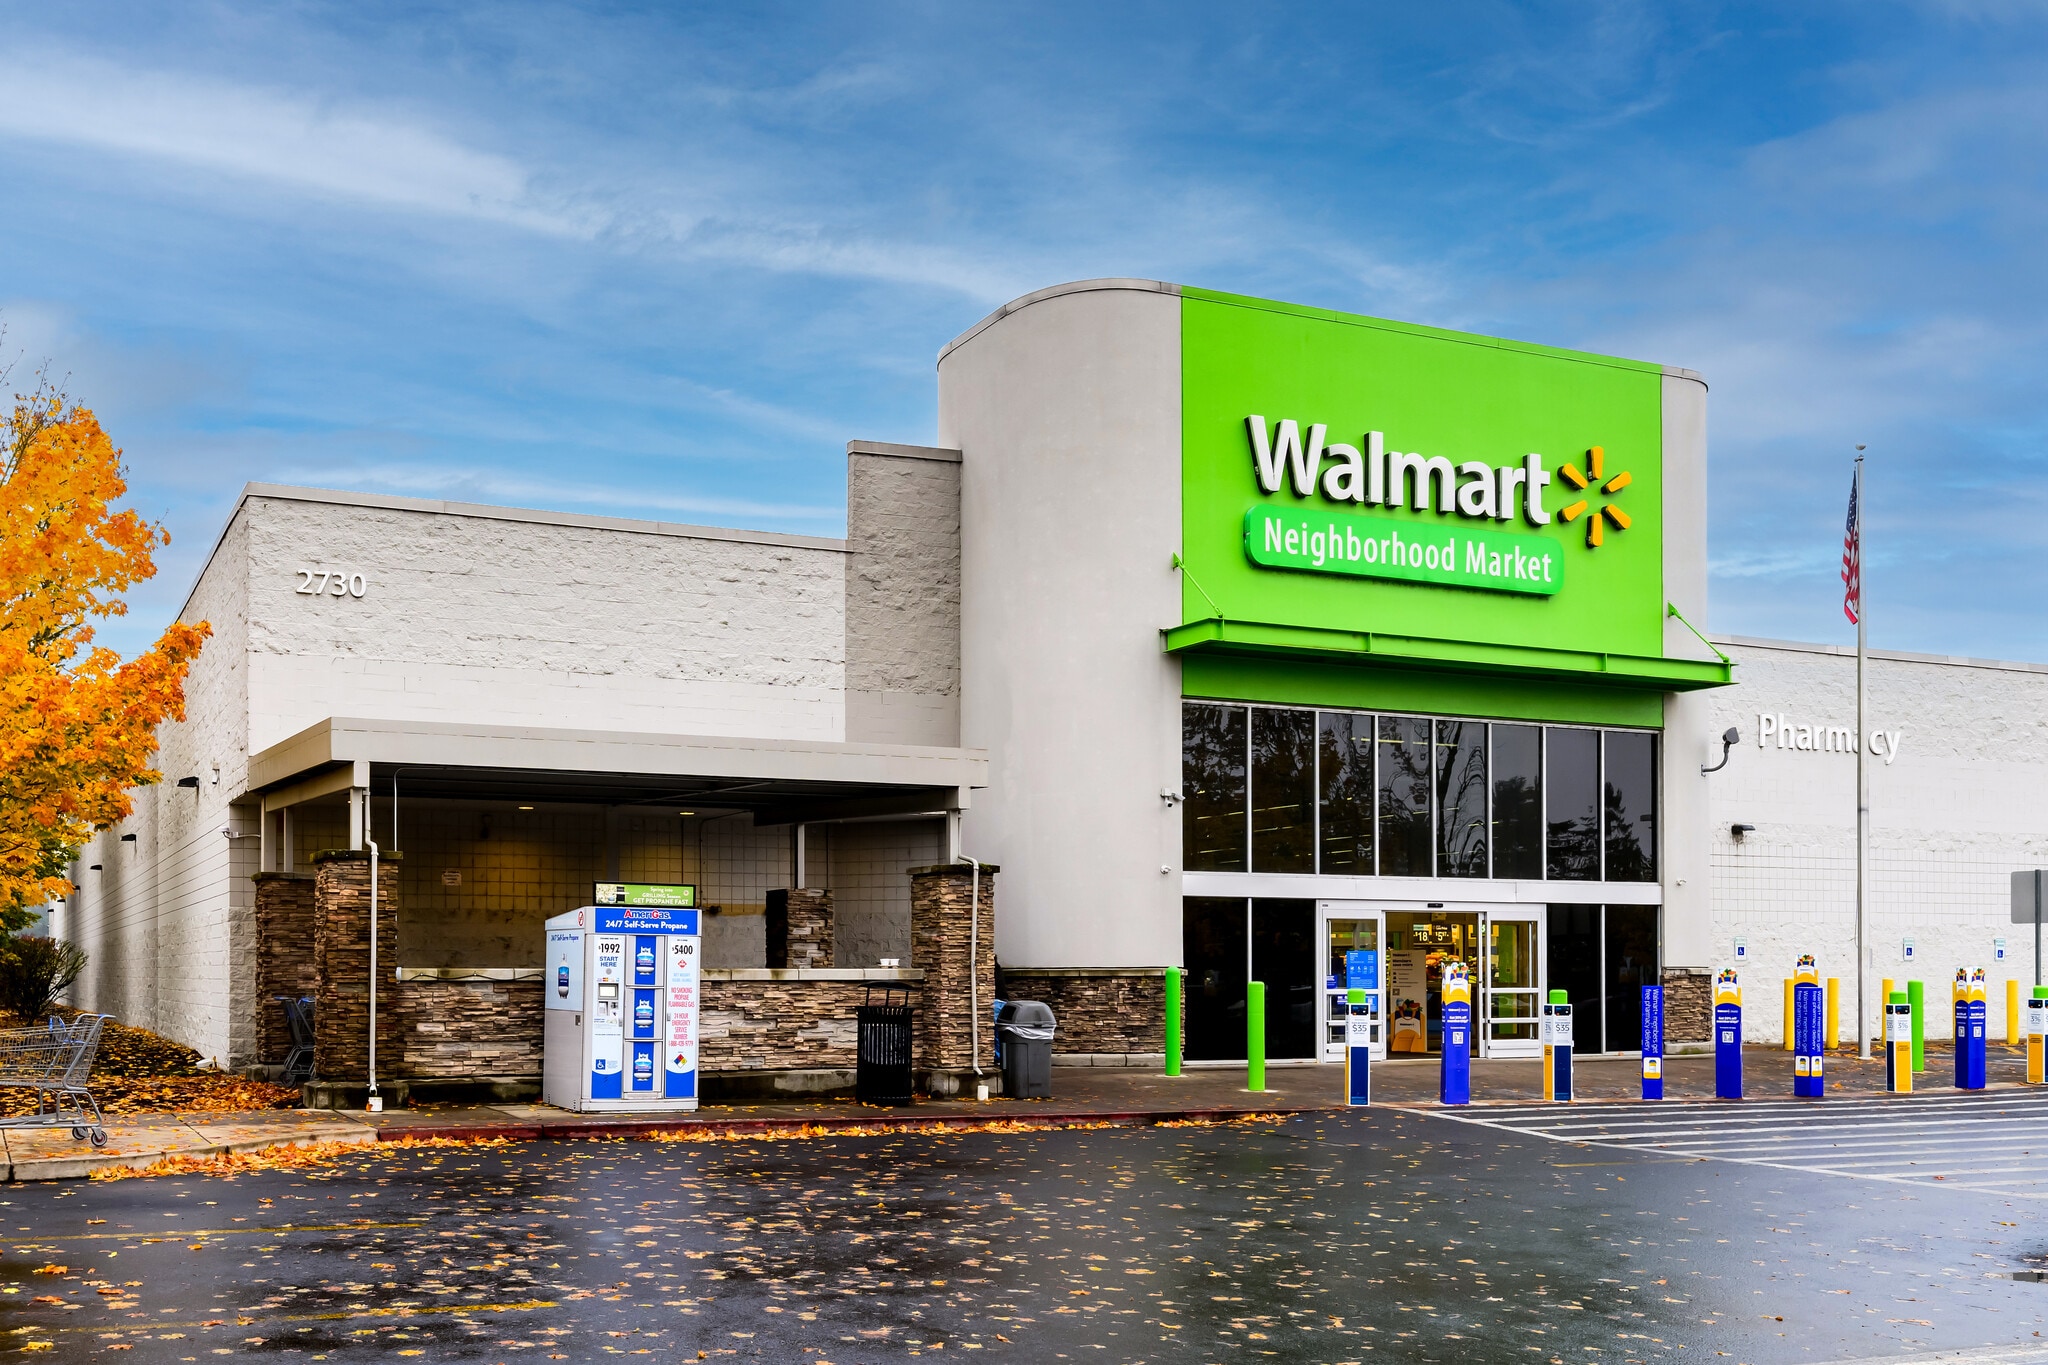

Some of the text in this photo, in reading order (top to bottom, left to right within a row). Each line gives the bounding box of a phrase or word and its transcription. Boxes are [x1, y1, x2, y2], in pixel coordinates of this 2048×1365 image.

[1244, 414, 1551, 526] Walmart
[1264, 517, 1552, 583] Neighborhood Market
[296, 568, 367, 598] 2730
[624, 909, 671, 919] AmeriGas
[605, 920, 688, 931] 24/7 Self-Serve Propane
[1352, 1024, 1367, 1033] $35
[1556, 1024, 1570, 1032] $35
